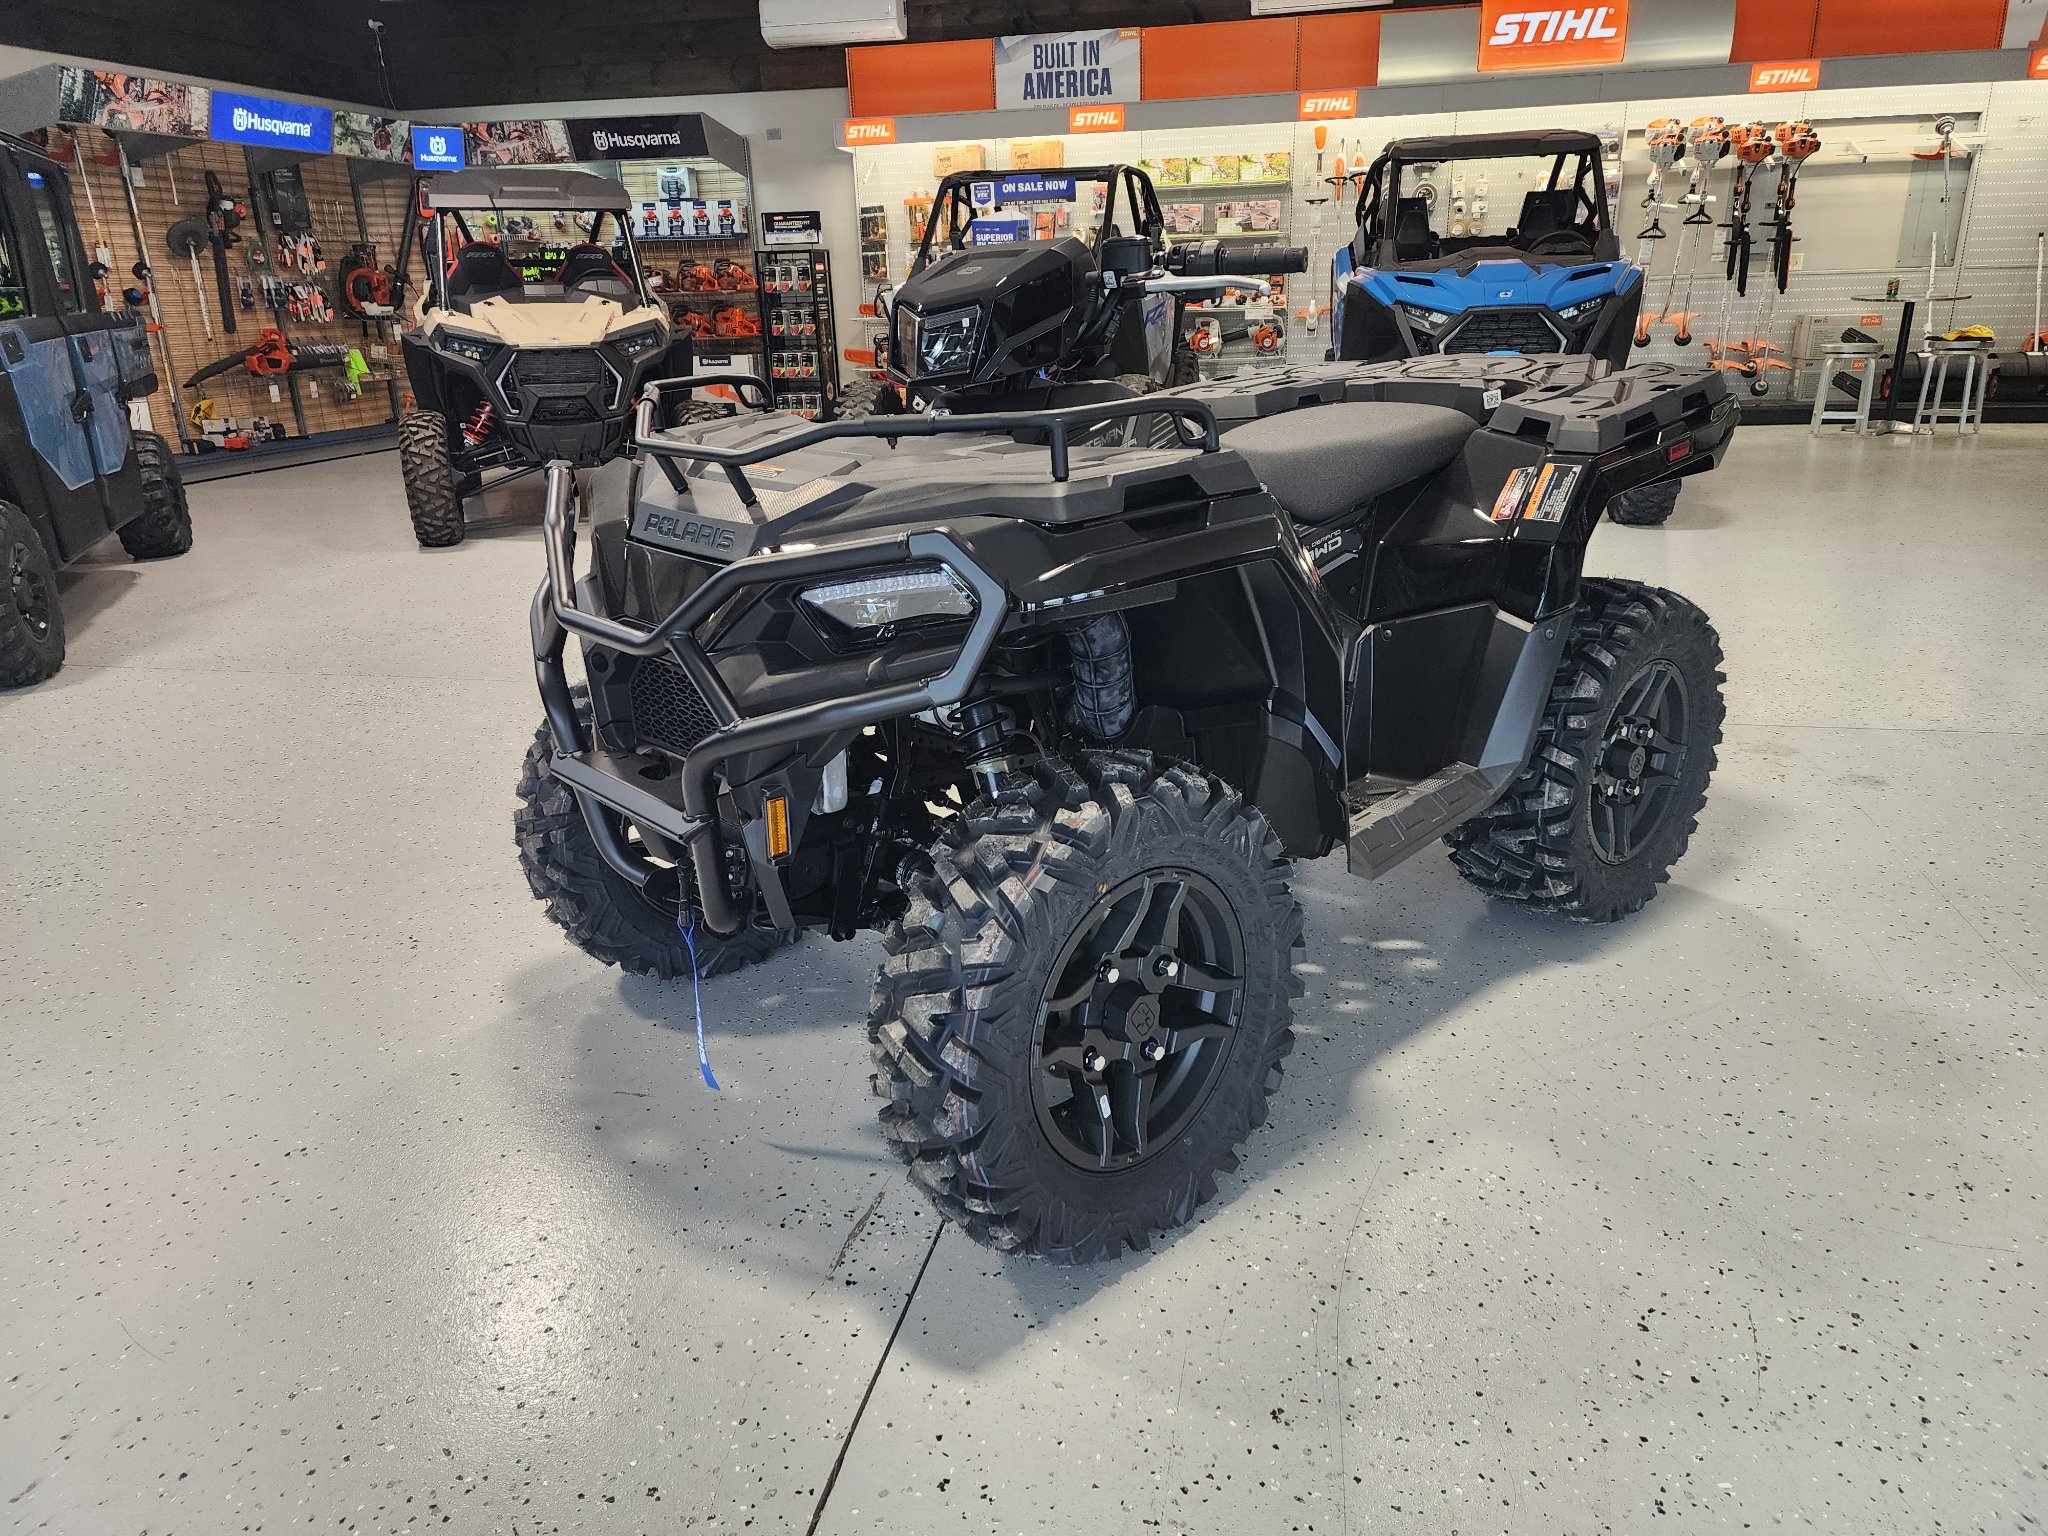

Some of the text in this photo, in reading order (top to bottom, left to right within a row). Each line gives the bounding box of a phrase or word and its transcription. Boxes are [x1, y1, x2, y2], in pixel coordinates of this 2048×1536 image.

[1119, 29, 1138, 38] STIHL
[1488, 7, 1617, 46] STIHL
[1033, 39, 1100, 69] BUILT IN
[1023, 67, 1113, 100] AMERICA
[1755, 68, 1812, 86] STIHL
[1302, 96, 1352, 113] STIHL
[248, 112, 311, 138] Husqvarna
[1073, 111, 1119, 126] STIHL
[847, 123, 891, 139] STIHL
[607, 131, 681, 149] Husqvarna
[420, 153, 457, 163] Husqvarna
[1002, 182, 1015, 193] ON
[1018, 181, 1043, 192] SALE
[1045, 180, 1068, 191] NOW
[976, 233, 1014, 242] SUPERIOR
[643, 512, 736, 552] POLARIS
